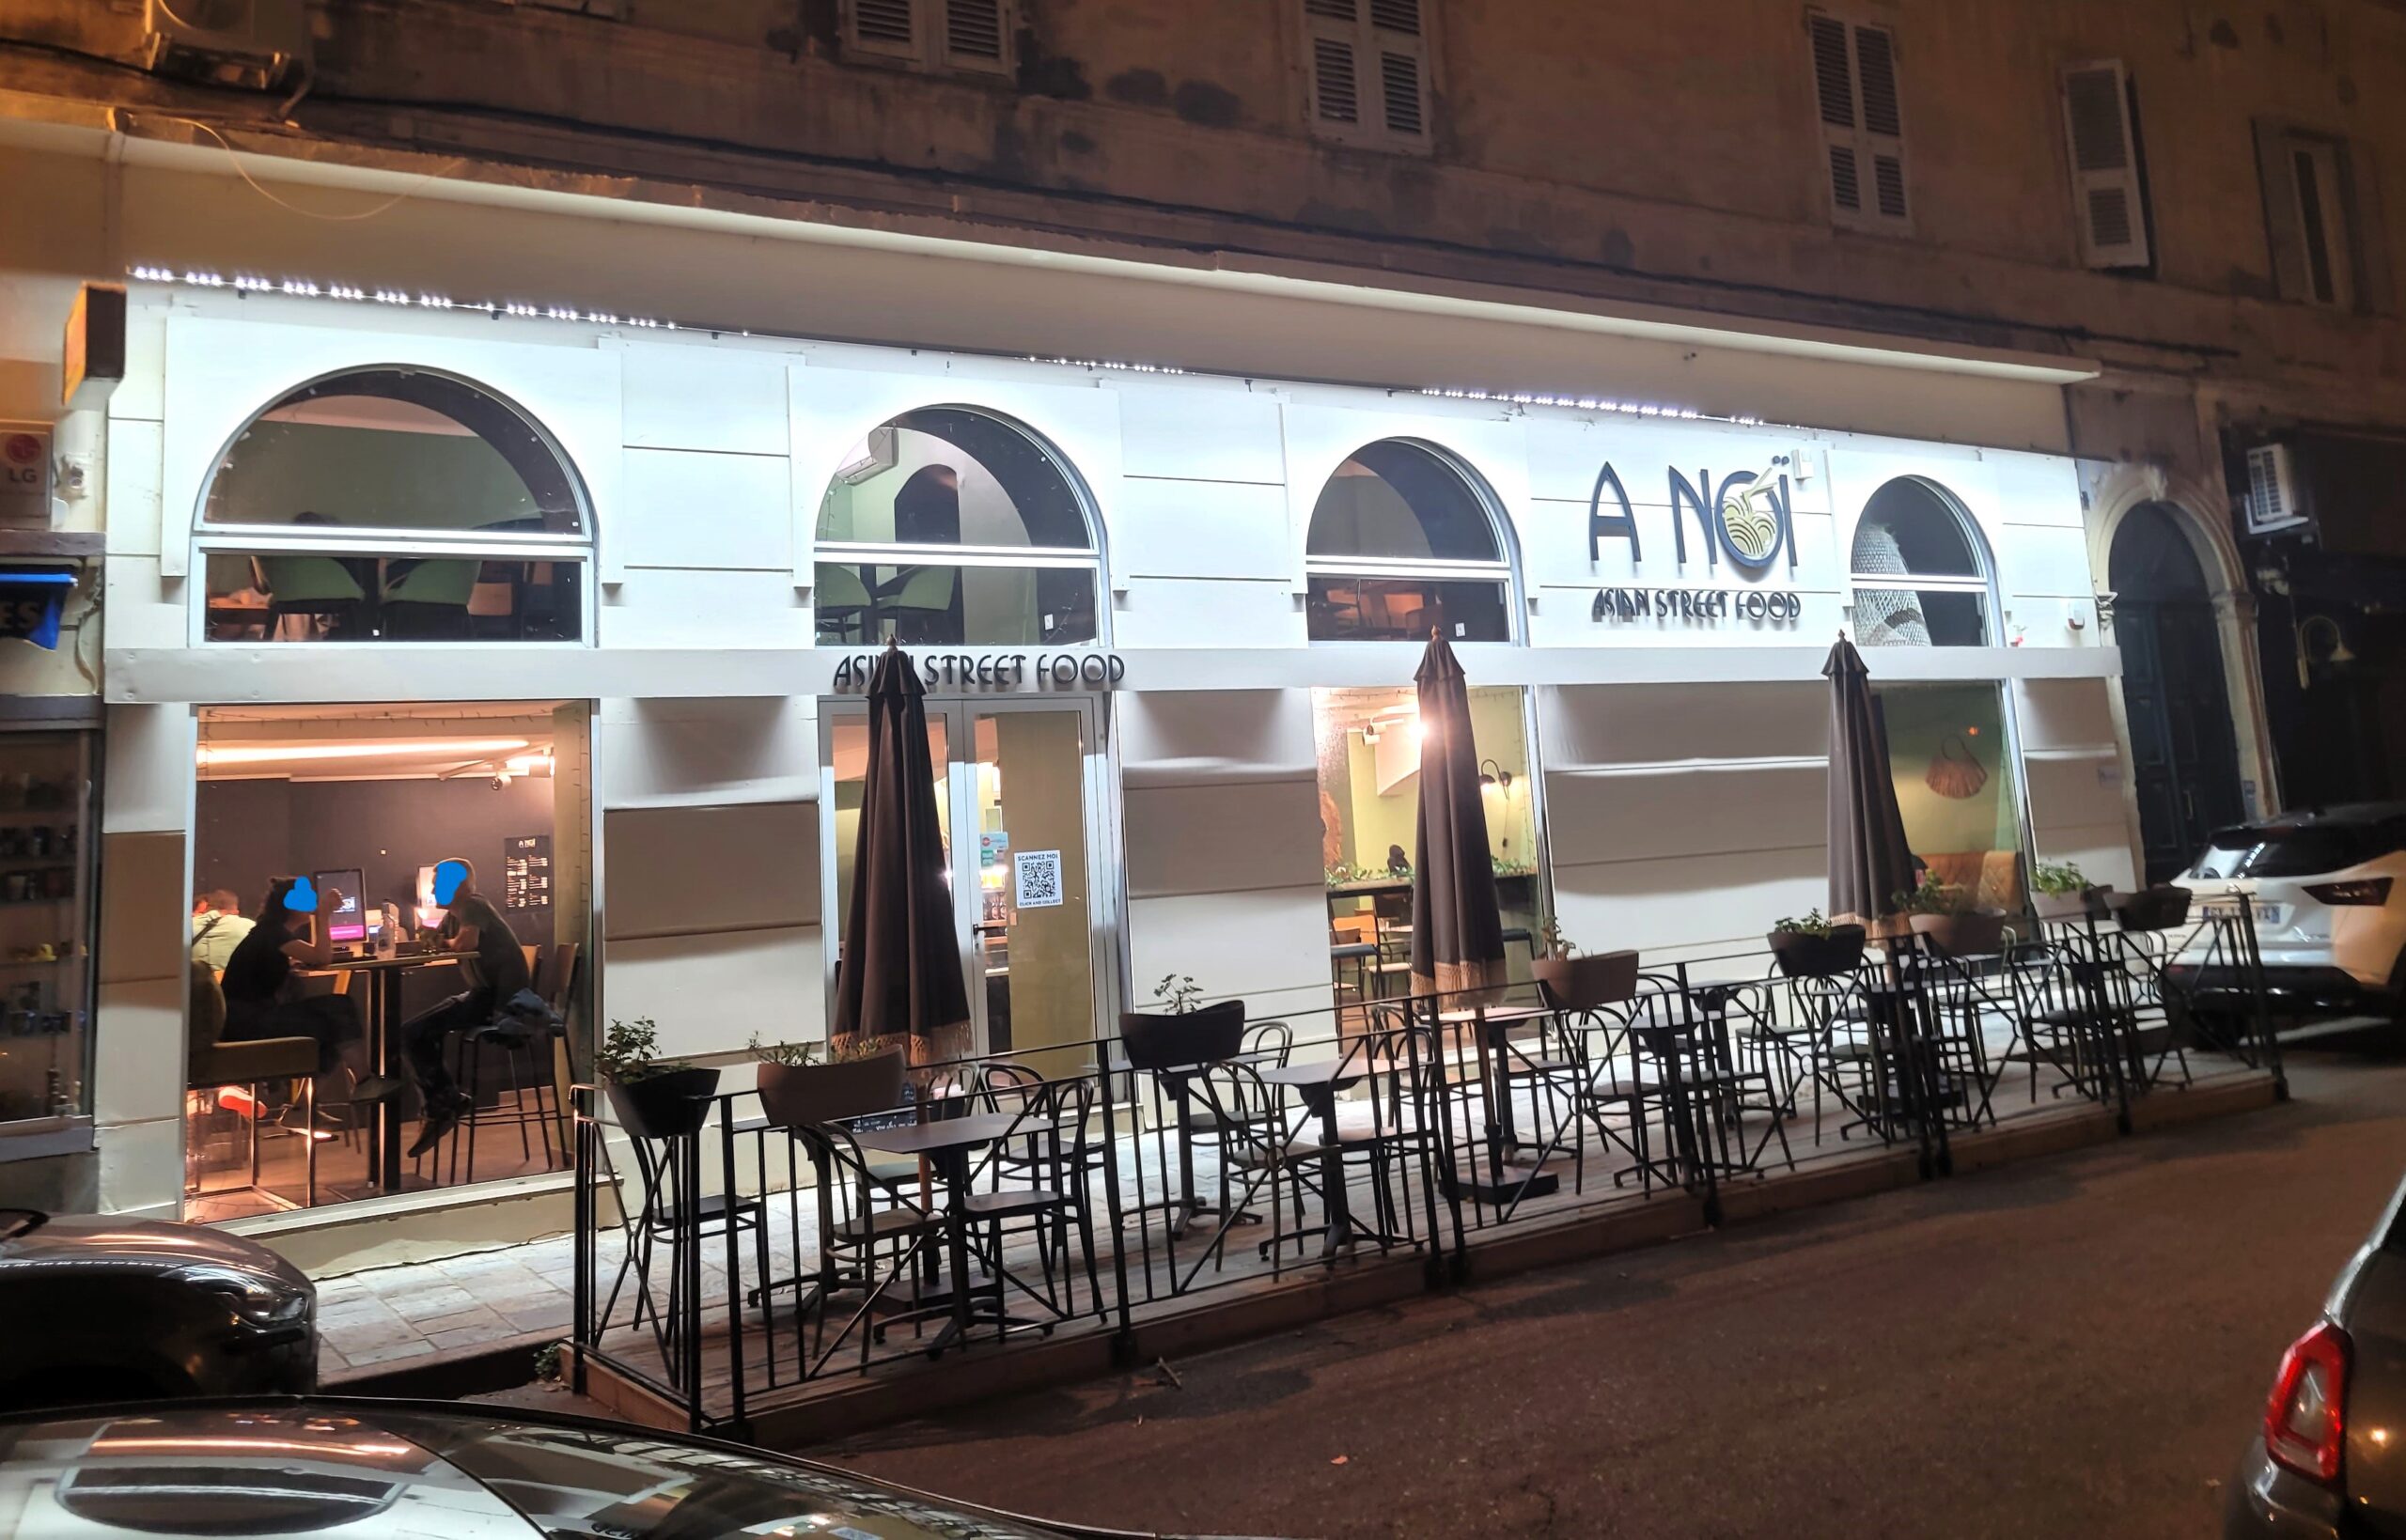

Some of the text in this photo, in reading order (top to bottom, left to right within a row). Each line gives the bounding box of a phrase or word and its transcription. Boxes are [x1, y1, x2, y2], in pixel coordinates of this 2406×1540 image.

[8, 468, 37, 483] LG
[1589, 461, 1642, 562] A
[1592, 588, 1801, 620] ASIAN STREET FOOD
[833, 654, 1125, 686] ASI STREET FOOD
